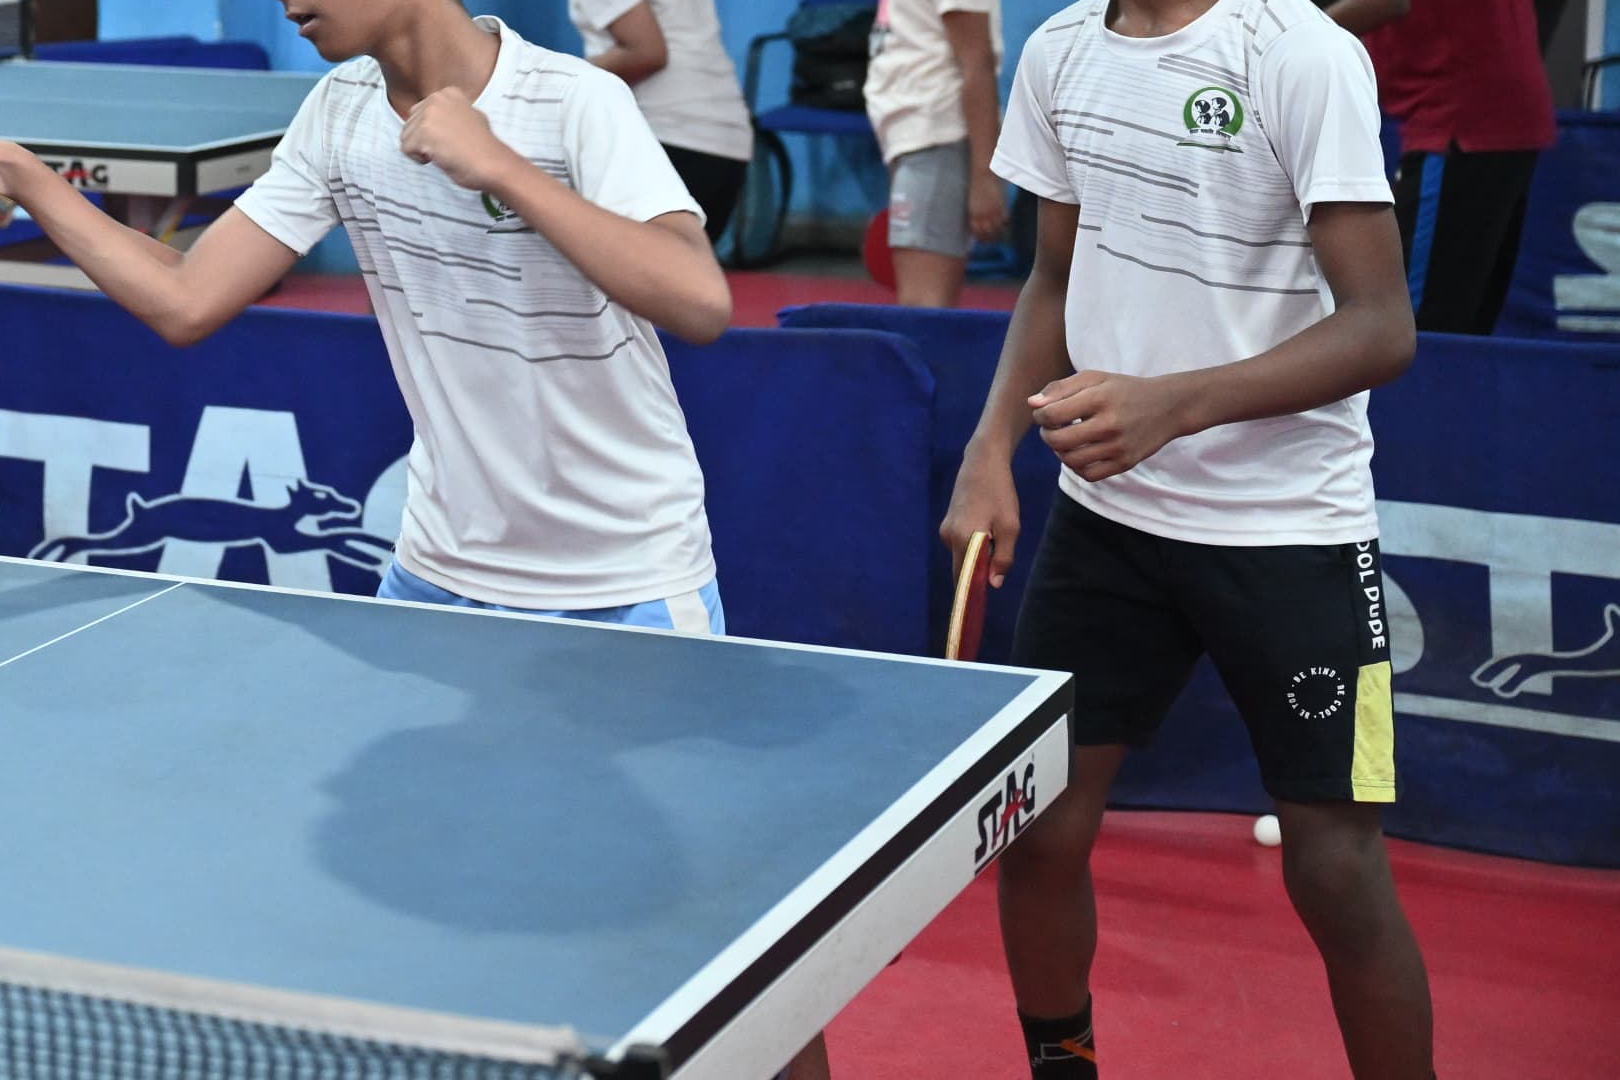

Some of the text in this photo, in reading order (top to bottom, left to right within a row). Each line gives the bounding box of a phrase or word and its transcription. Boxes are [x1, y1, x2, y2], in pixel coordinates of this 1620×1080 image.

[1363, 585, 1386, 650] DUDE
[1287, 666, 1345, 720] BE KIND BE COOL BE YOU
[974, 762, 1036, 866] STAG
